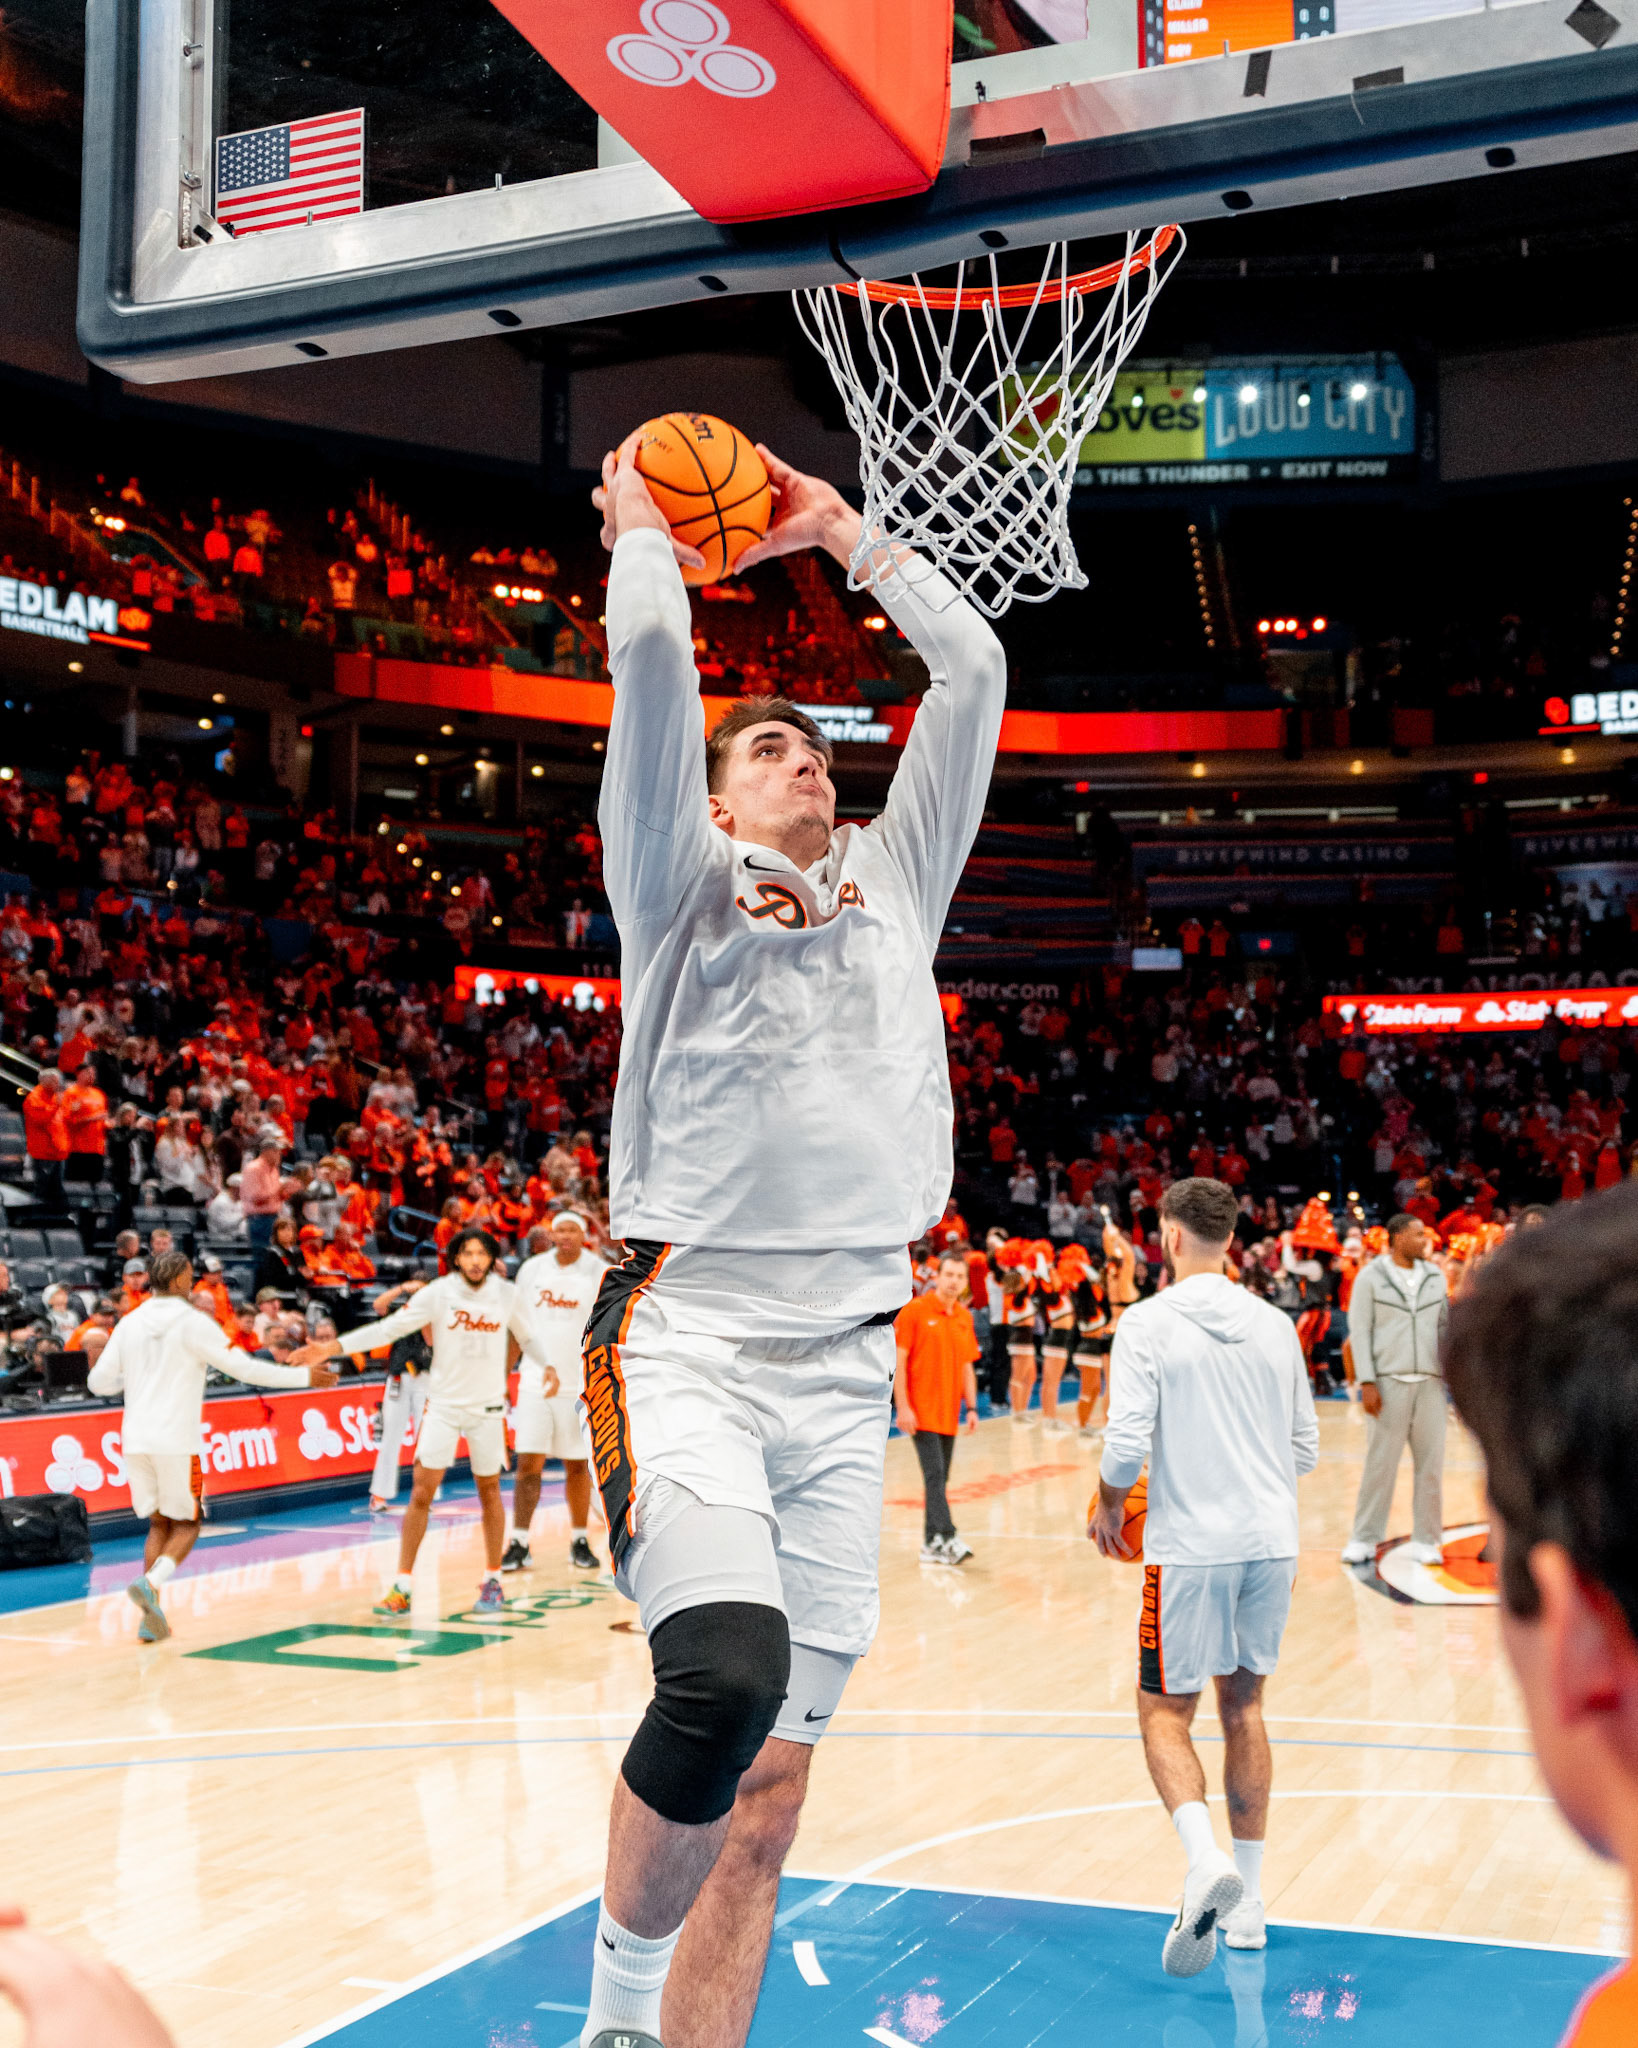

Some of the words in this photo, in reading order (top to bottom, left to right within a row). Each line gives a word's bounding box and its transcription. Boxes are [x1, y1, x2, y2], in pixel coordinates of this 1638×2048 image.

[1100, 468, 1139, 484] THE
[1145, 464, 1249, 483] THUNDER
[1281, 463, 1331, 479] EXIT
[1336, 460, 1388, 477] NOW
[0, 575, 119, 635] EDLAM
[0, 611, 91, 645] BASKETBALL
[1320, 845, 1410, 862] CASINO
[535, 1289, 581, 1310] Pokes
[448, 1310, 502, 1333] Pokes
[1139, 1565, 1159, 1650] COWBOYS
